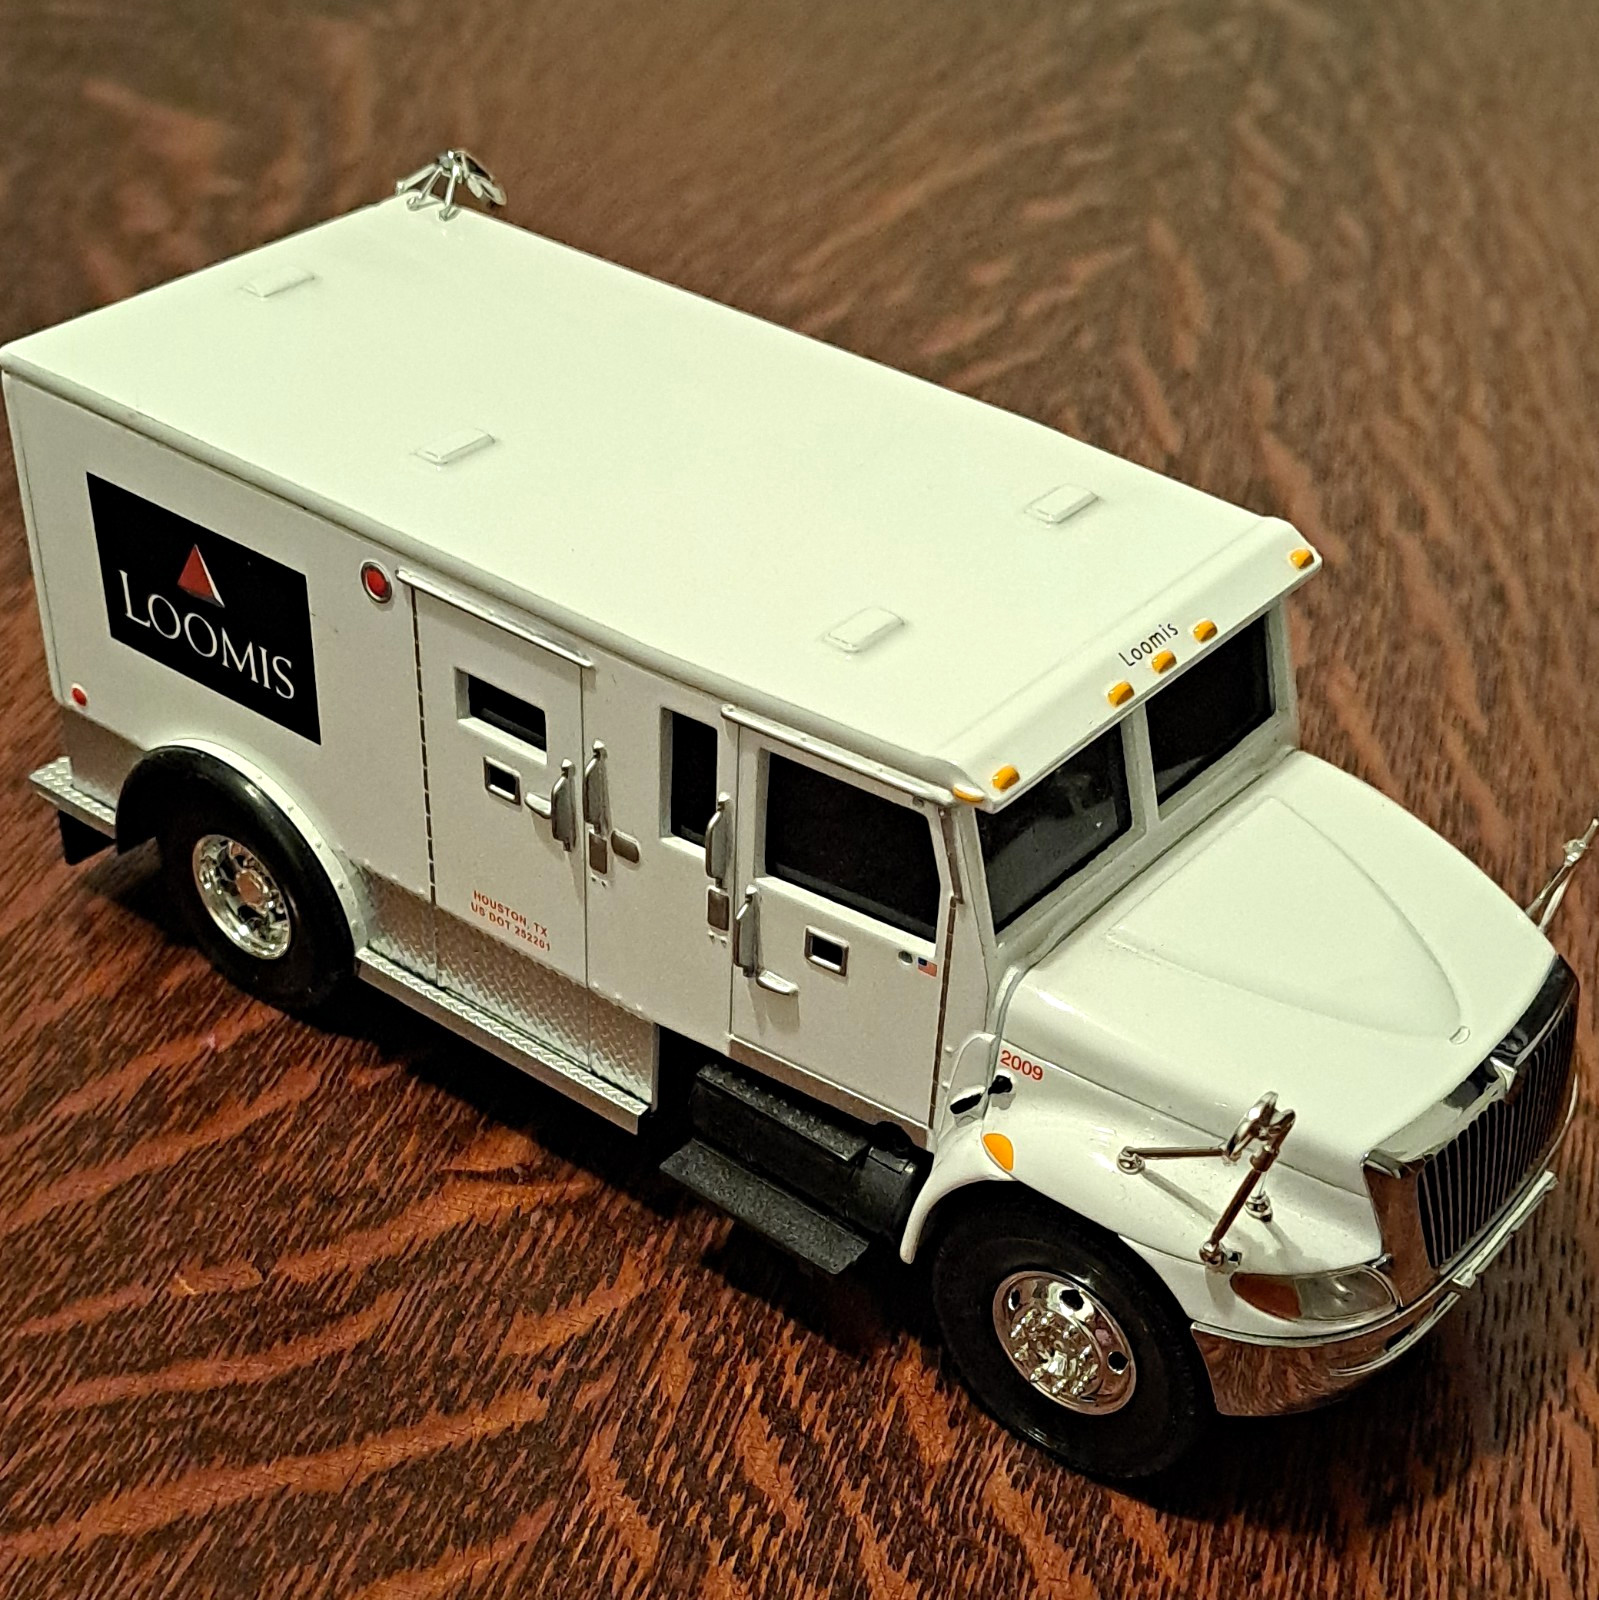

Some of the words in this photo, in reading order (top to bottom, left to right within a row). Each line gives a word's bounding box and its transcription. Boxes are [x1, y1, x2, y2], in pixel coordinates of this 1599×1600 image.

[118, 569, 295, 700] LOOMIS
[1118, 623, 1179, 667] Loomis
[470, 901, 486, 917] US
[488, 912, 511, 931] DOT
[514, 925, 551, 952] 252201
[473, 889, 530, 930] HOUSTON,
[533, 922, 548, 938] TX
[1000, 1049, 1044, 1081] 2009
